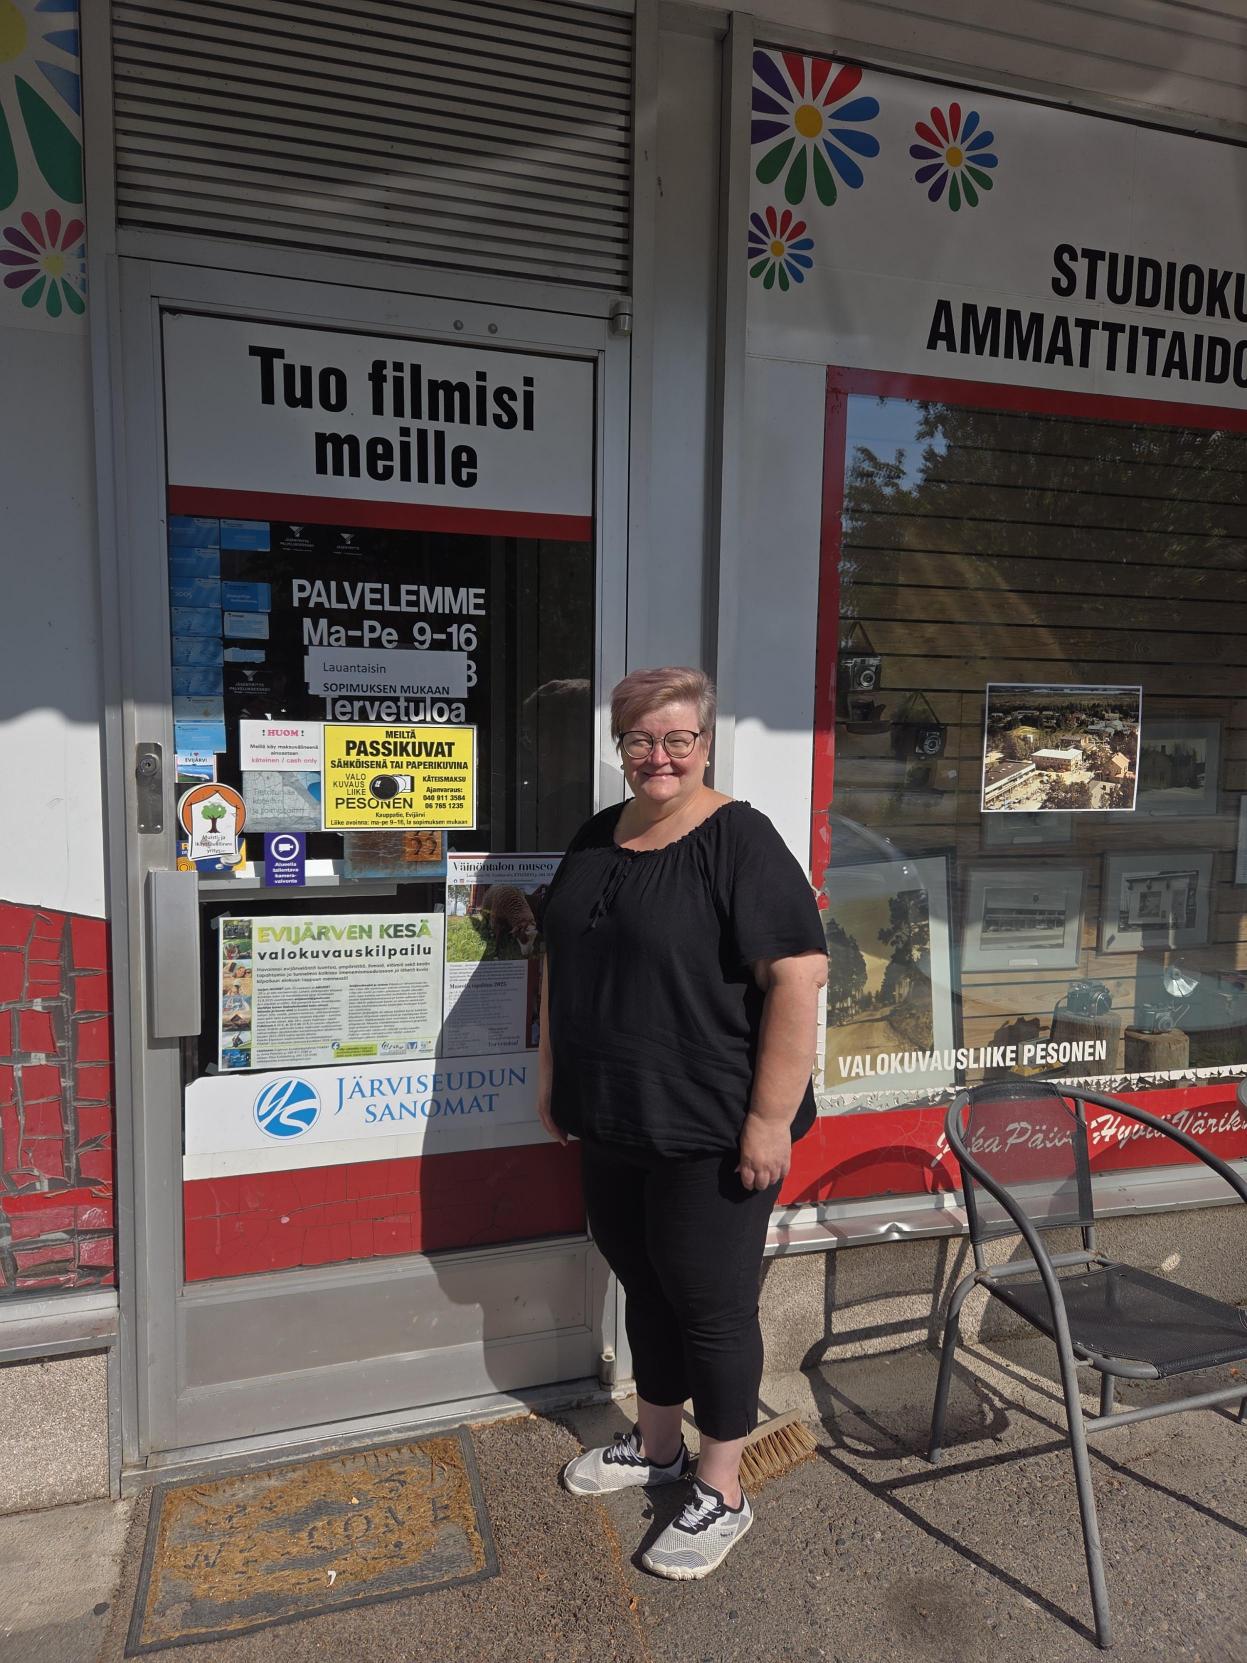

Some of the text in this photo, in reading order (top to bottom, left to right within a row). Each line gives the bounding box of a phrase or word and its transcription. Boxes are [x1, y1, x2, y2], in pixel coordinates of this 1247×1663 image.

[248, 345, 534, 431] Tuo filmisi
[315, 426, 478, 488] meille
[292, 578, 486, 616] PALVELEMME
[302, 617, 478, 652] Ma-Pe 9-16
[323, 662, 386, 674] Lauantaisin
[323, 682, 450, 696] SOPIMUKSEN MUKAAN
[319, 695, 466, 722] Tervetuloa
[267, 729, 299, 737] HUOM
[385, 729, 416, 740] MEILTÄ
[345, 740, 455, 758] PASSIKUVAT
[330, 758, 469, 770] SÄHKÖISENÄ TAI PAPERIKUVINA
[422, 775, 467, 783] KÄTEISMAKSU
[346, 788, 367, 796] LIIKE
[335, 797, 413, 810] PESONEN
[453, 861, 554, 872] Väinöntalon museo
[257, 919, 432, 945] EVIJÄRVEN KESÄ
[257, 944, 432, 960] valokuvauskilpailu
[838, 1039, 1107, 1078] VALOKUVAUSLIIKE PESONEN
[334, 1066, 527, 1116] JÄRVISEUDUN
[364, 1093, 500, 1123] SANOMAT
